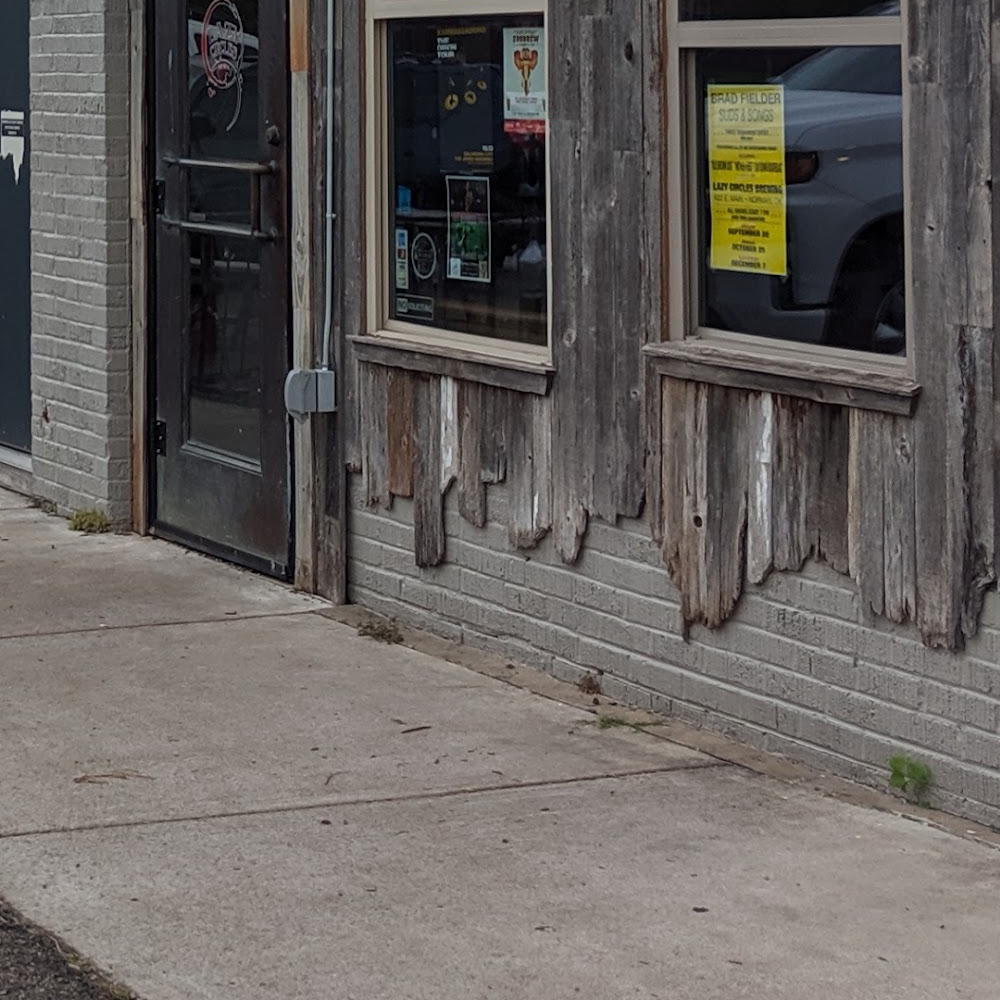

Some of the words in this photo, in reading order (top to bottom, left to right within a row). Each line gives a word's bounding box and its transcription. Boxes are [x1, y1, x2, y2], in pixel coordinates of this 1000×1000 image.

[711, 92, 738, 104] BRAD
[740, 93, 781, 104] FIELDER
[719, 108, 739, 121] SUDS
[747, 108, 774, 122] SONGS
[713, 182, 728, 191] LAZY
[729, 183, 753, 192] CIRCLES
